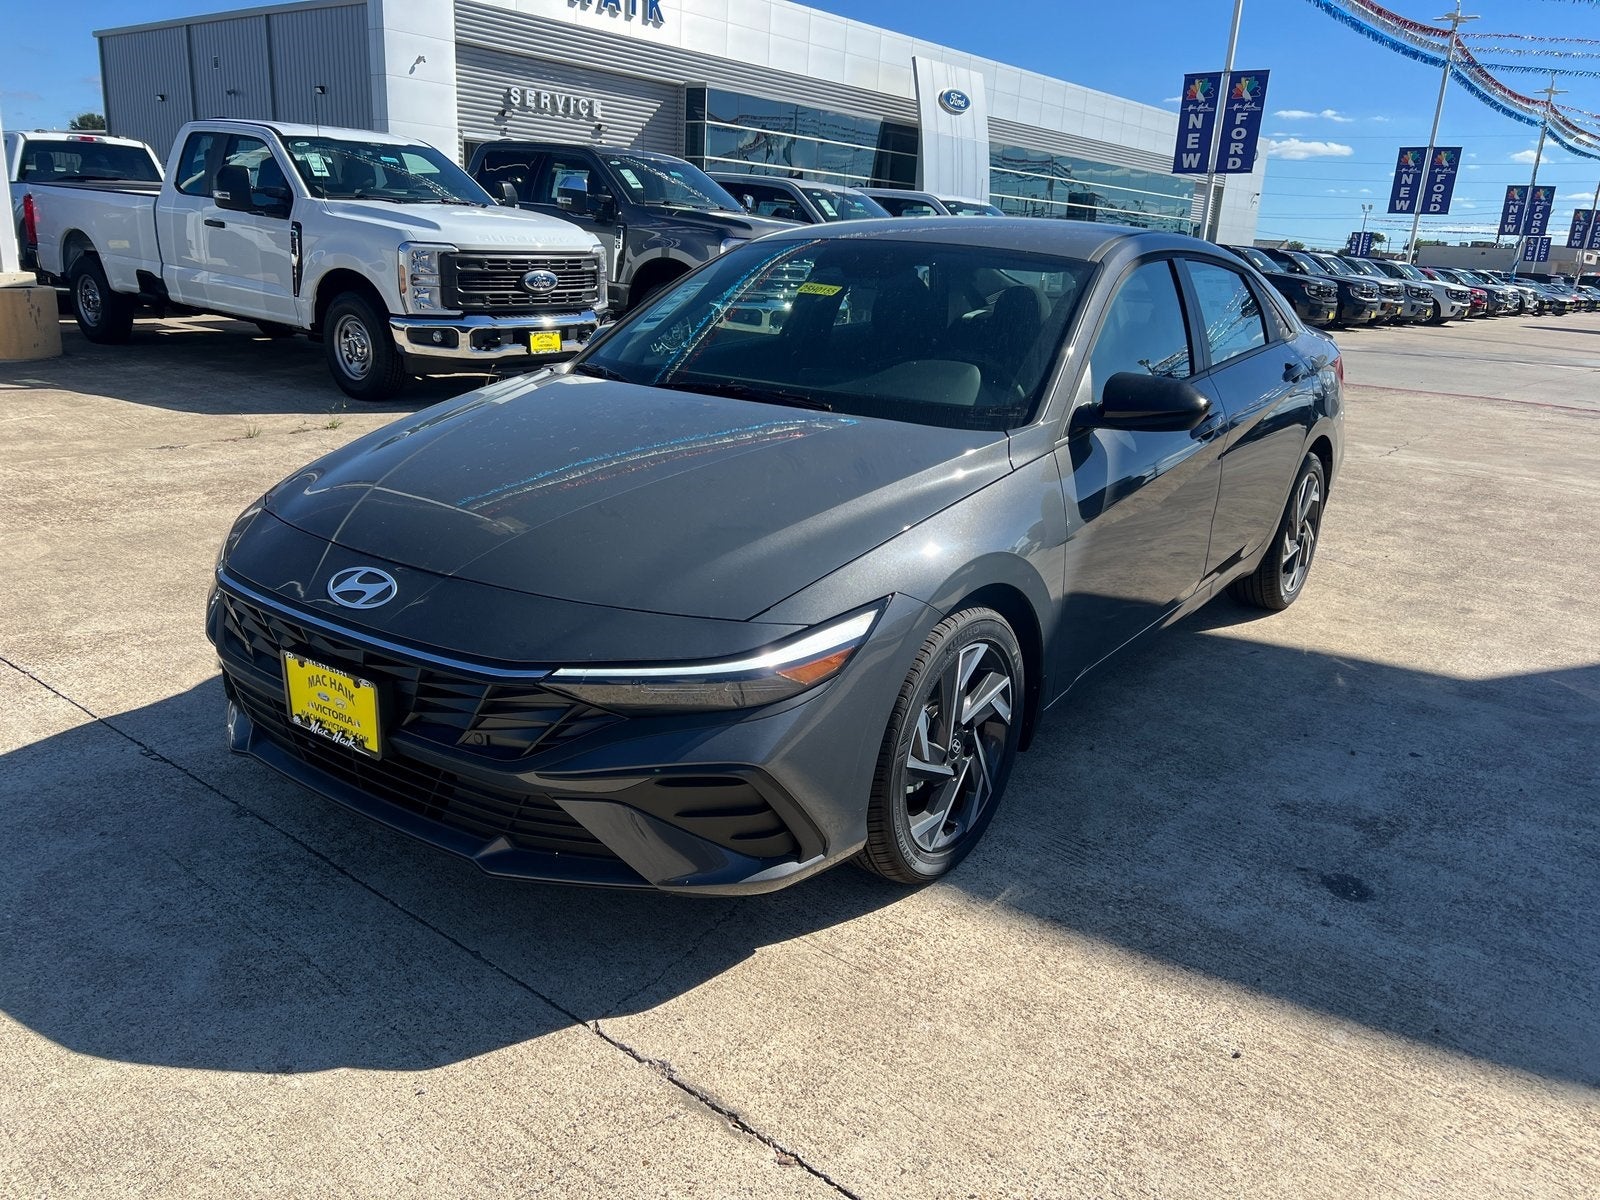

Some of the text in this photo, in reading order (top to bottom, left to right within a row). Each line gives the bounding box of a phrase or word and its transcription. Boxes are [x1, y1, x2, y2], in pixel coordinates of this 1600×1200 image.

[569, 0, 666, 23] AIK
[509, 86, 602, 118] SERVICE
[1182, 113, 1204, 169] NEW
[1226, 112, 1249, 170] FORD
[1395, 173, 1413, 211] NEW
[1429, 174, 1446, 212] FORD
[1504, 205, 1519, 233] NEW
[1530, 205, 1543, 234] FORD
[1571, 224, 1583, 247] NEW
[308, 674, 328, 688] MAC
[329, 677, 355, 706] HAIK
[313, 703, 354, 724] VICTORIA
[309, 721, 356, 748] Mac Haik
